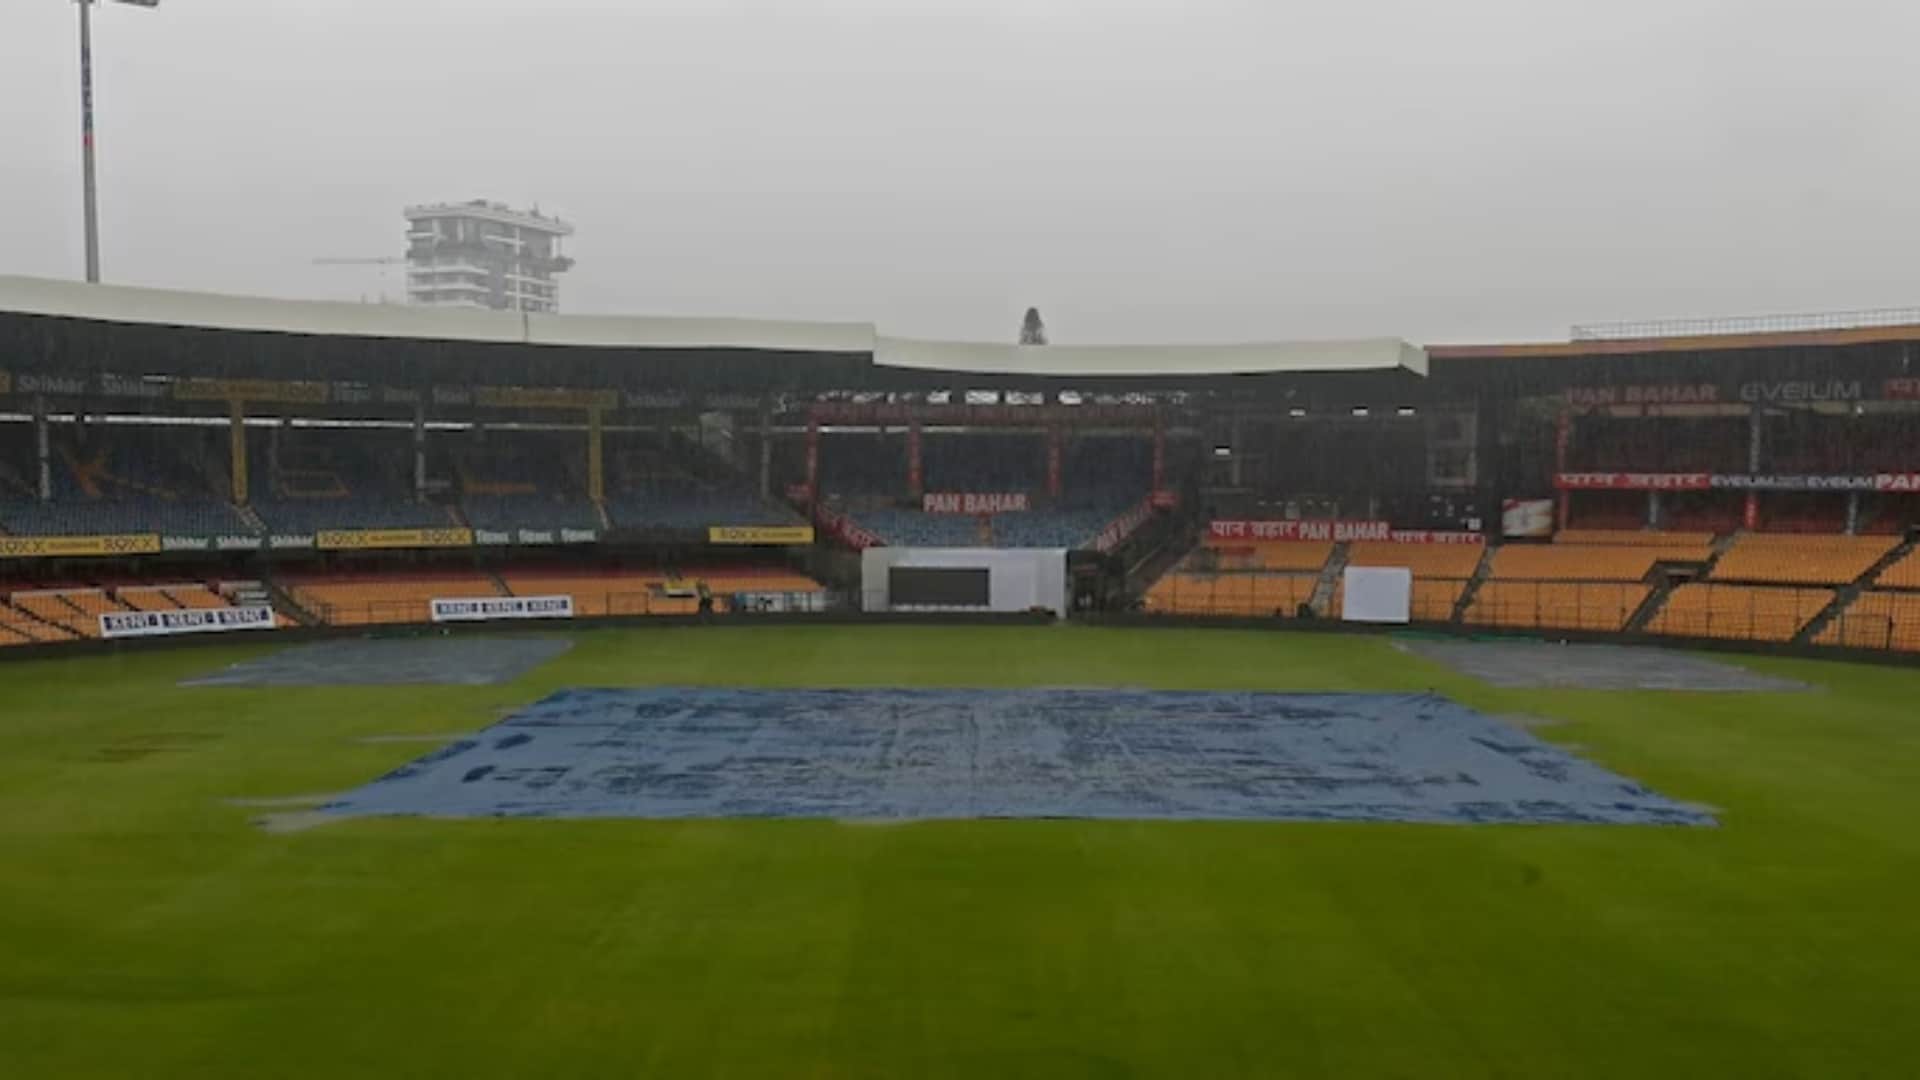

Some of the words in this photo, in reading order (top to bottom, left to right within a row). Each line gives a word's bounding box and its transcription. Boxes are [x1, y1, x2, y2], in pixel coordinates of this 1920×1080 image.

[1625, 384, 1718, 402] BAHAR
[923, 493, 959, 511] PAN
[965, 493, 1026, 511] BAHAR
[1299, 522, 1328, 540] PAN
[1334, 521, 1390, 539] BAHAR
